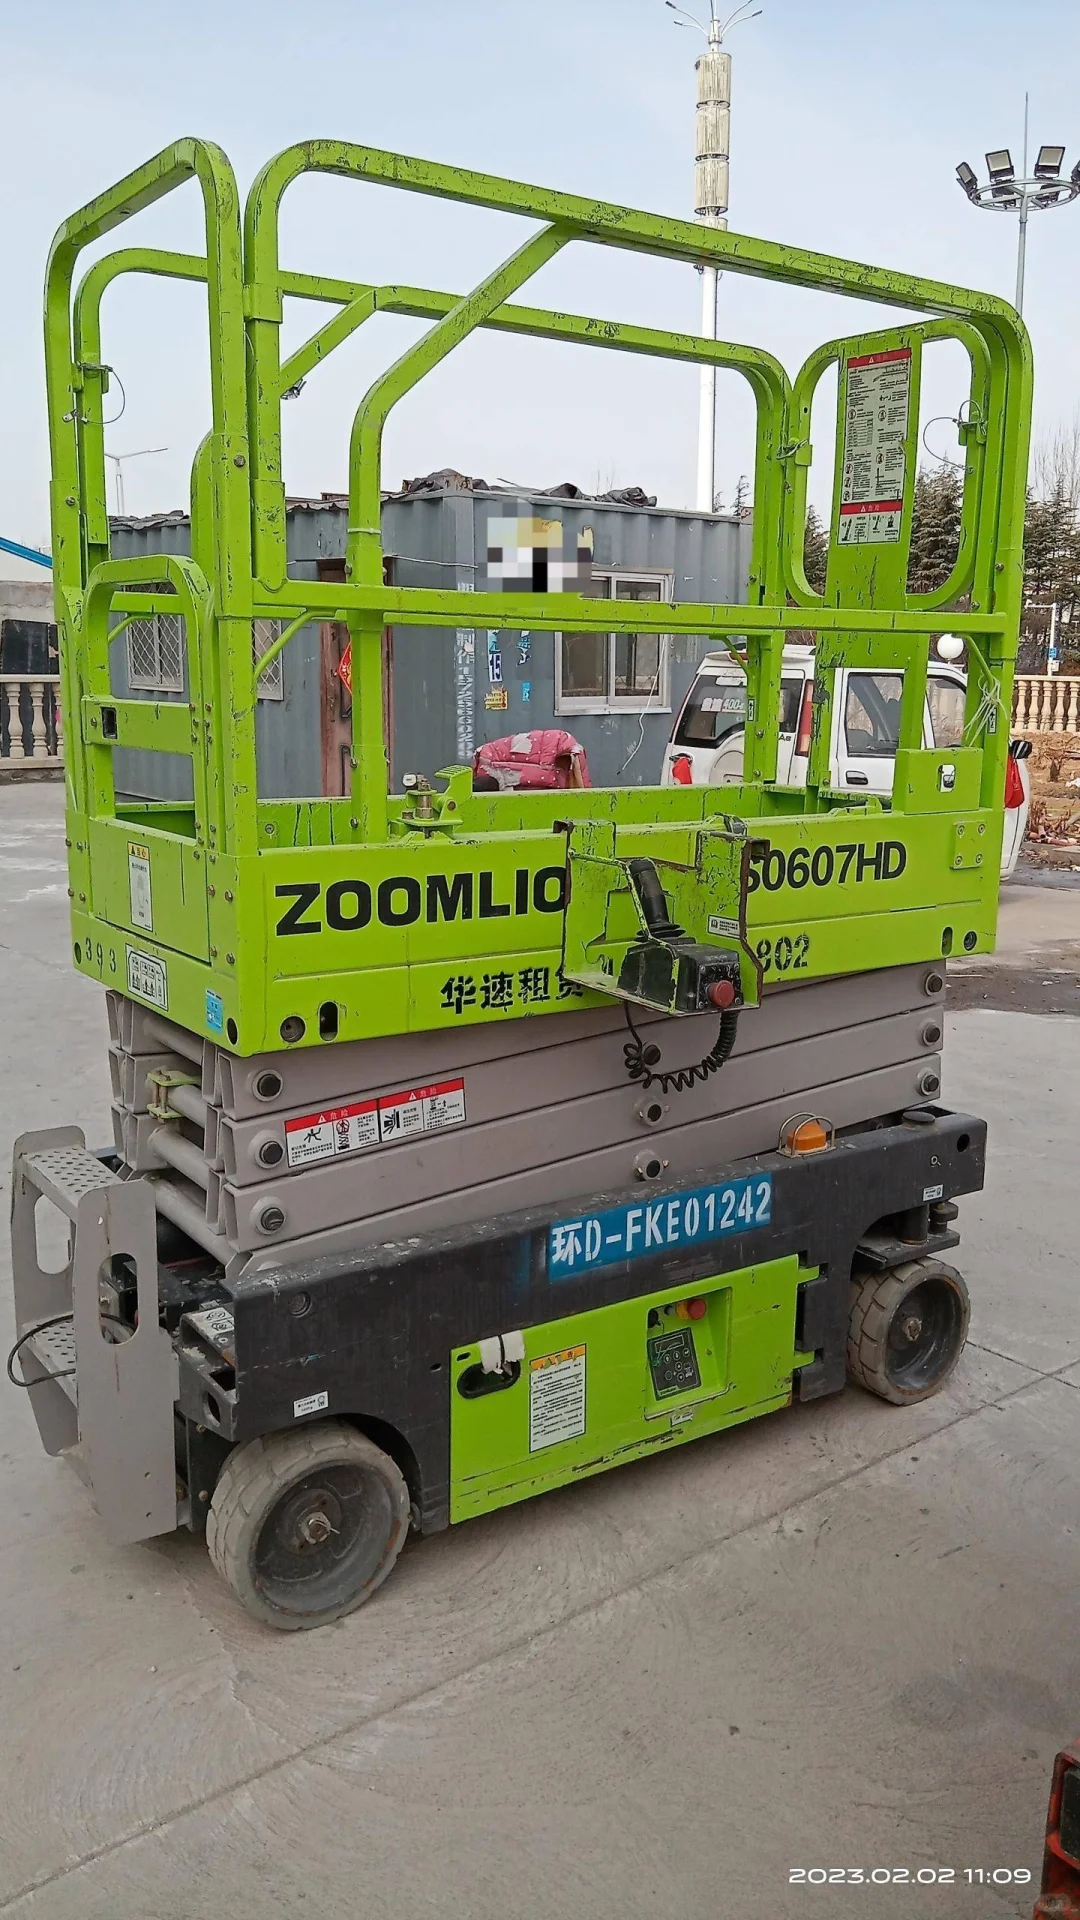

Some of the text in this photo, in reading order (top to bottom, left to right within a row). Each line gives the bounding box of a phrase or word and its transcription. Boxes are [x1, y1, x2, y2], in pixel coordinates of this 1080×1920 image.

[490, 654, 501, 680] 15
[275, 866, 567, 936] ZOOMLIO
[85, 937, 117, 979] 393
[419, 1086, 437, 1098] 危险
[330, 1108, 349, 1120] 危险
[551, 1180, 772, 1266] 环D-FKE01242
